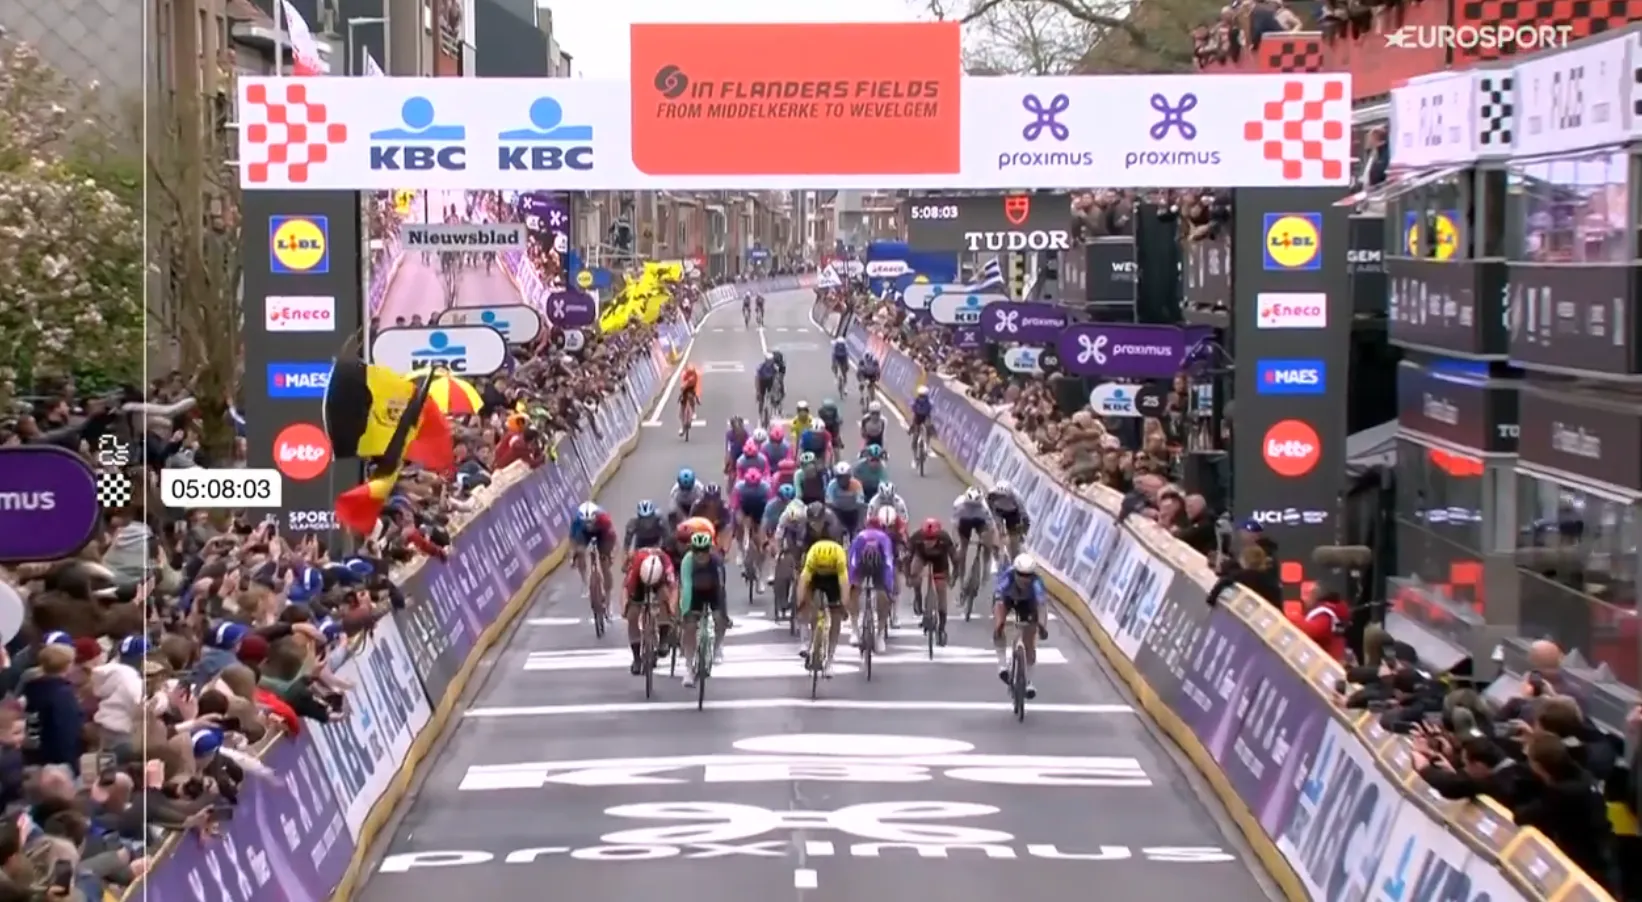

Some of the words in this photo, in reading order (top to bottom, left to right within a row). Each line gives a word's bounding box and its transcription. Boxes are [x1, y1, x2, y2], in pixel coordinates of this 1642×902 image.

[692, 81, 713, 98] IN
[720, 81, 848, 98] FLANDERS
[855, 81, 939, 98] FIELDS
[657, 103, 702, 118] FROM
[707, 102, 819, 118] MIDDELKERKE
[825, 102, 843, 117] TO
[850, 102, 938, 117] WEVELGEM
[370, 147, 466, 170] KBC
[498, 147, 593, 170] KBC
[999, 150, 1093, 170] proximus
[1125, 149, 1221, 169] proximus
[911, 206, 959, 219] 5:08:03
[408, 230, 520, 246] Nieuwsblad
[965, 230, 1070, 251] TUDOR
[282, 306, 331, 320] Eneco
[955, 313, 978, 321] KB
[1273, 303, 1321, 317] Eneco
[1113, 343, 1172, 356] proximus
[285, 373, 328, 388] MAES
[1275, 369, 1318, 384] MAES
[279, 443, 325, 461] lotto
[1267, 439, 1313, 457] lotto
[1252, 510, 1282, 523] UCI
[458, 764, 1153, 790] KBC
[379, 840, 1236, 872] proximus
